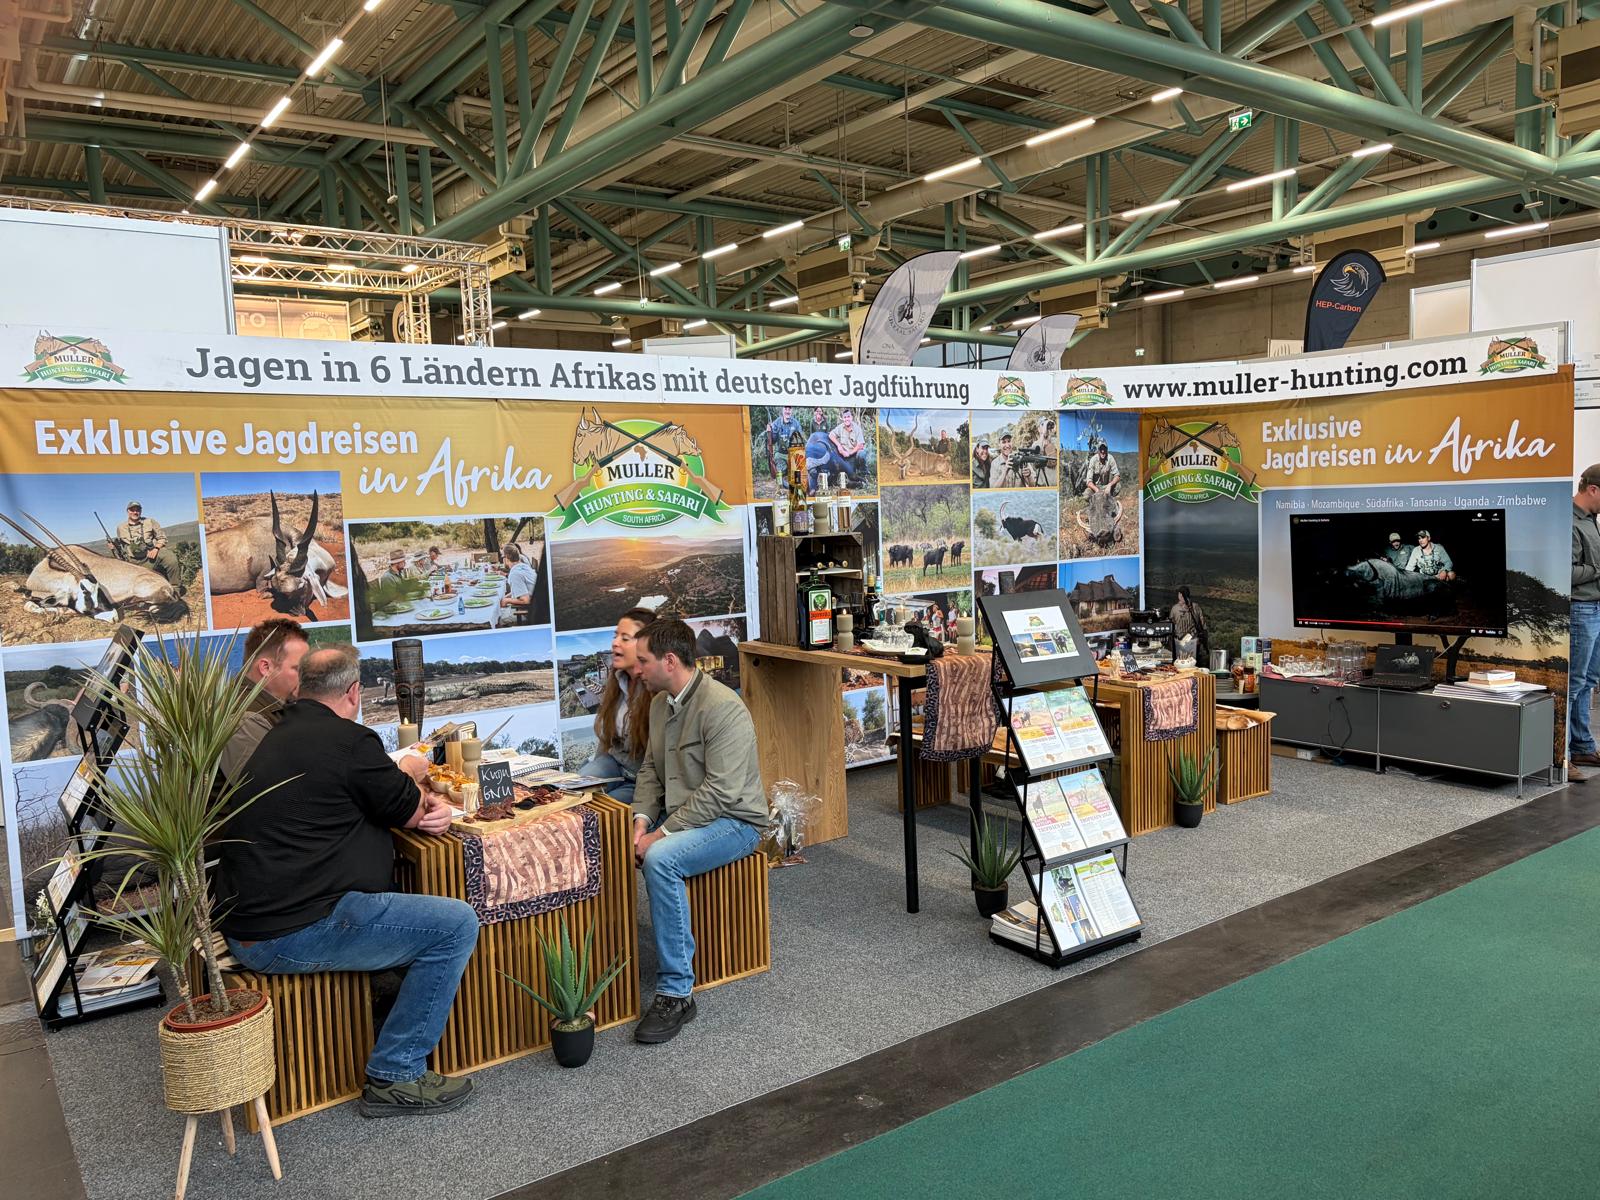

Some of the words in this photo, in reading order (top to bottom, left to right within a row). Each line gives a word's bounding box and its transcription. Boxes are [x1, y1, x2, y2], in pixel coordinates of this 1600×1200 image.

[1315, 300, 1362, 312] HEP-Carbon
[54, 355, 94, 364] MULLER
[1500, 351, 1526, 359] MULLER
[40, 366, 75, 378] HUNTING
[83, 366, 111, 378] SAFARI
[186, 347, 313, 387] Jagen
[321, 351, 361, 383] in
[370, 355, 391, 384] 6
[400, 356, 541, 388] Ländern
[550, 361, 657, 392] Afrikas
[663, 366, 708, 393] mit
[715, 368, 833, 396] deutscher
[839, 374, 970, 405] Jagdführung
[1123, 352, 1468, 399] www.muller-hunting.com
[1261, 416, 1362, 443] Exklusive
[34, 418, 227, 456] Exklusive
[234, 421, 418, 464] Jagdreisen
[1261, 444, 1377, 475] Jagdreisen
[1384, 443, 1422, 465] in
[1427, 416, 1556, 474] Afrika
[1170, 454, 1218, 468] MULLER
[359, 466, 408, 495] in
[415, 436, 553, 508] Afrika
[607, 463, 675, 482] MULLER
[1153, 474, 1194, 493] HUNTING
[1196, 473, 1203, 482] &
[1203, 474, 1237, 492] SAFARI
[582, 488, 643, 516] HUNTING
[645, 489, 656, 501] &
[656, 489, 701, 513] SAFARI
[1275, 499, 1305, 509] Namibia
[1311, 499, 1360, 510] Mozambique
[1366, 497, 1404, 509] Südafrika
[1410, 497, 1447, 508] Tansania
[1454, 496, 1490, 509] Uganda
[1497, 494, 1547, 506] Zimbabwe
[622, 514, 643, 524] SOUTH
[644, 513, 666, 524] AFRICA
